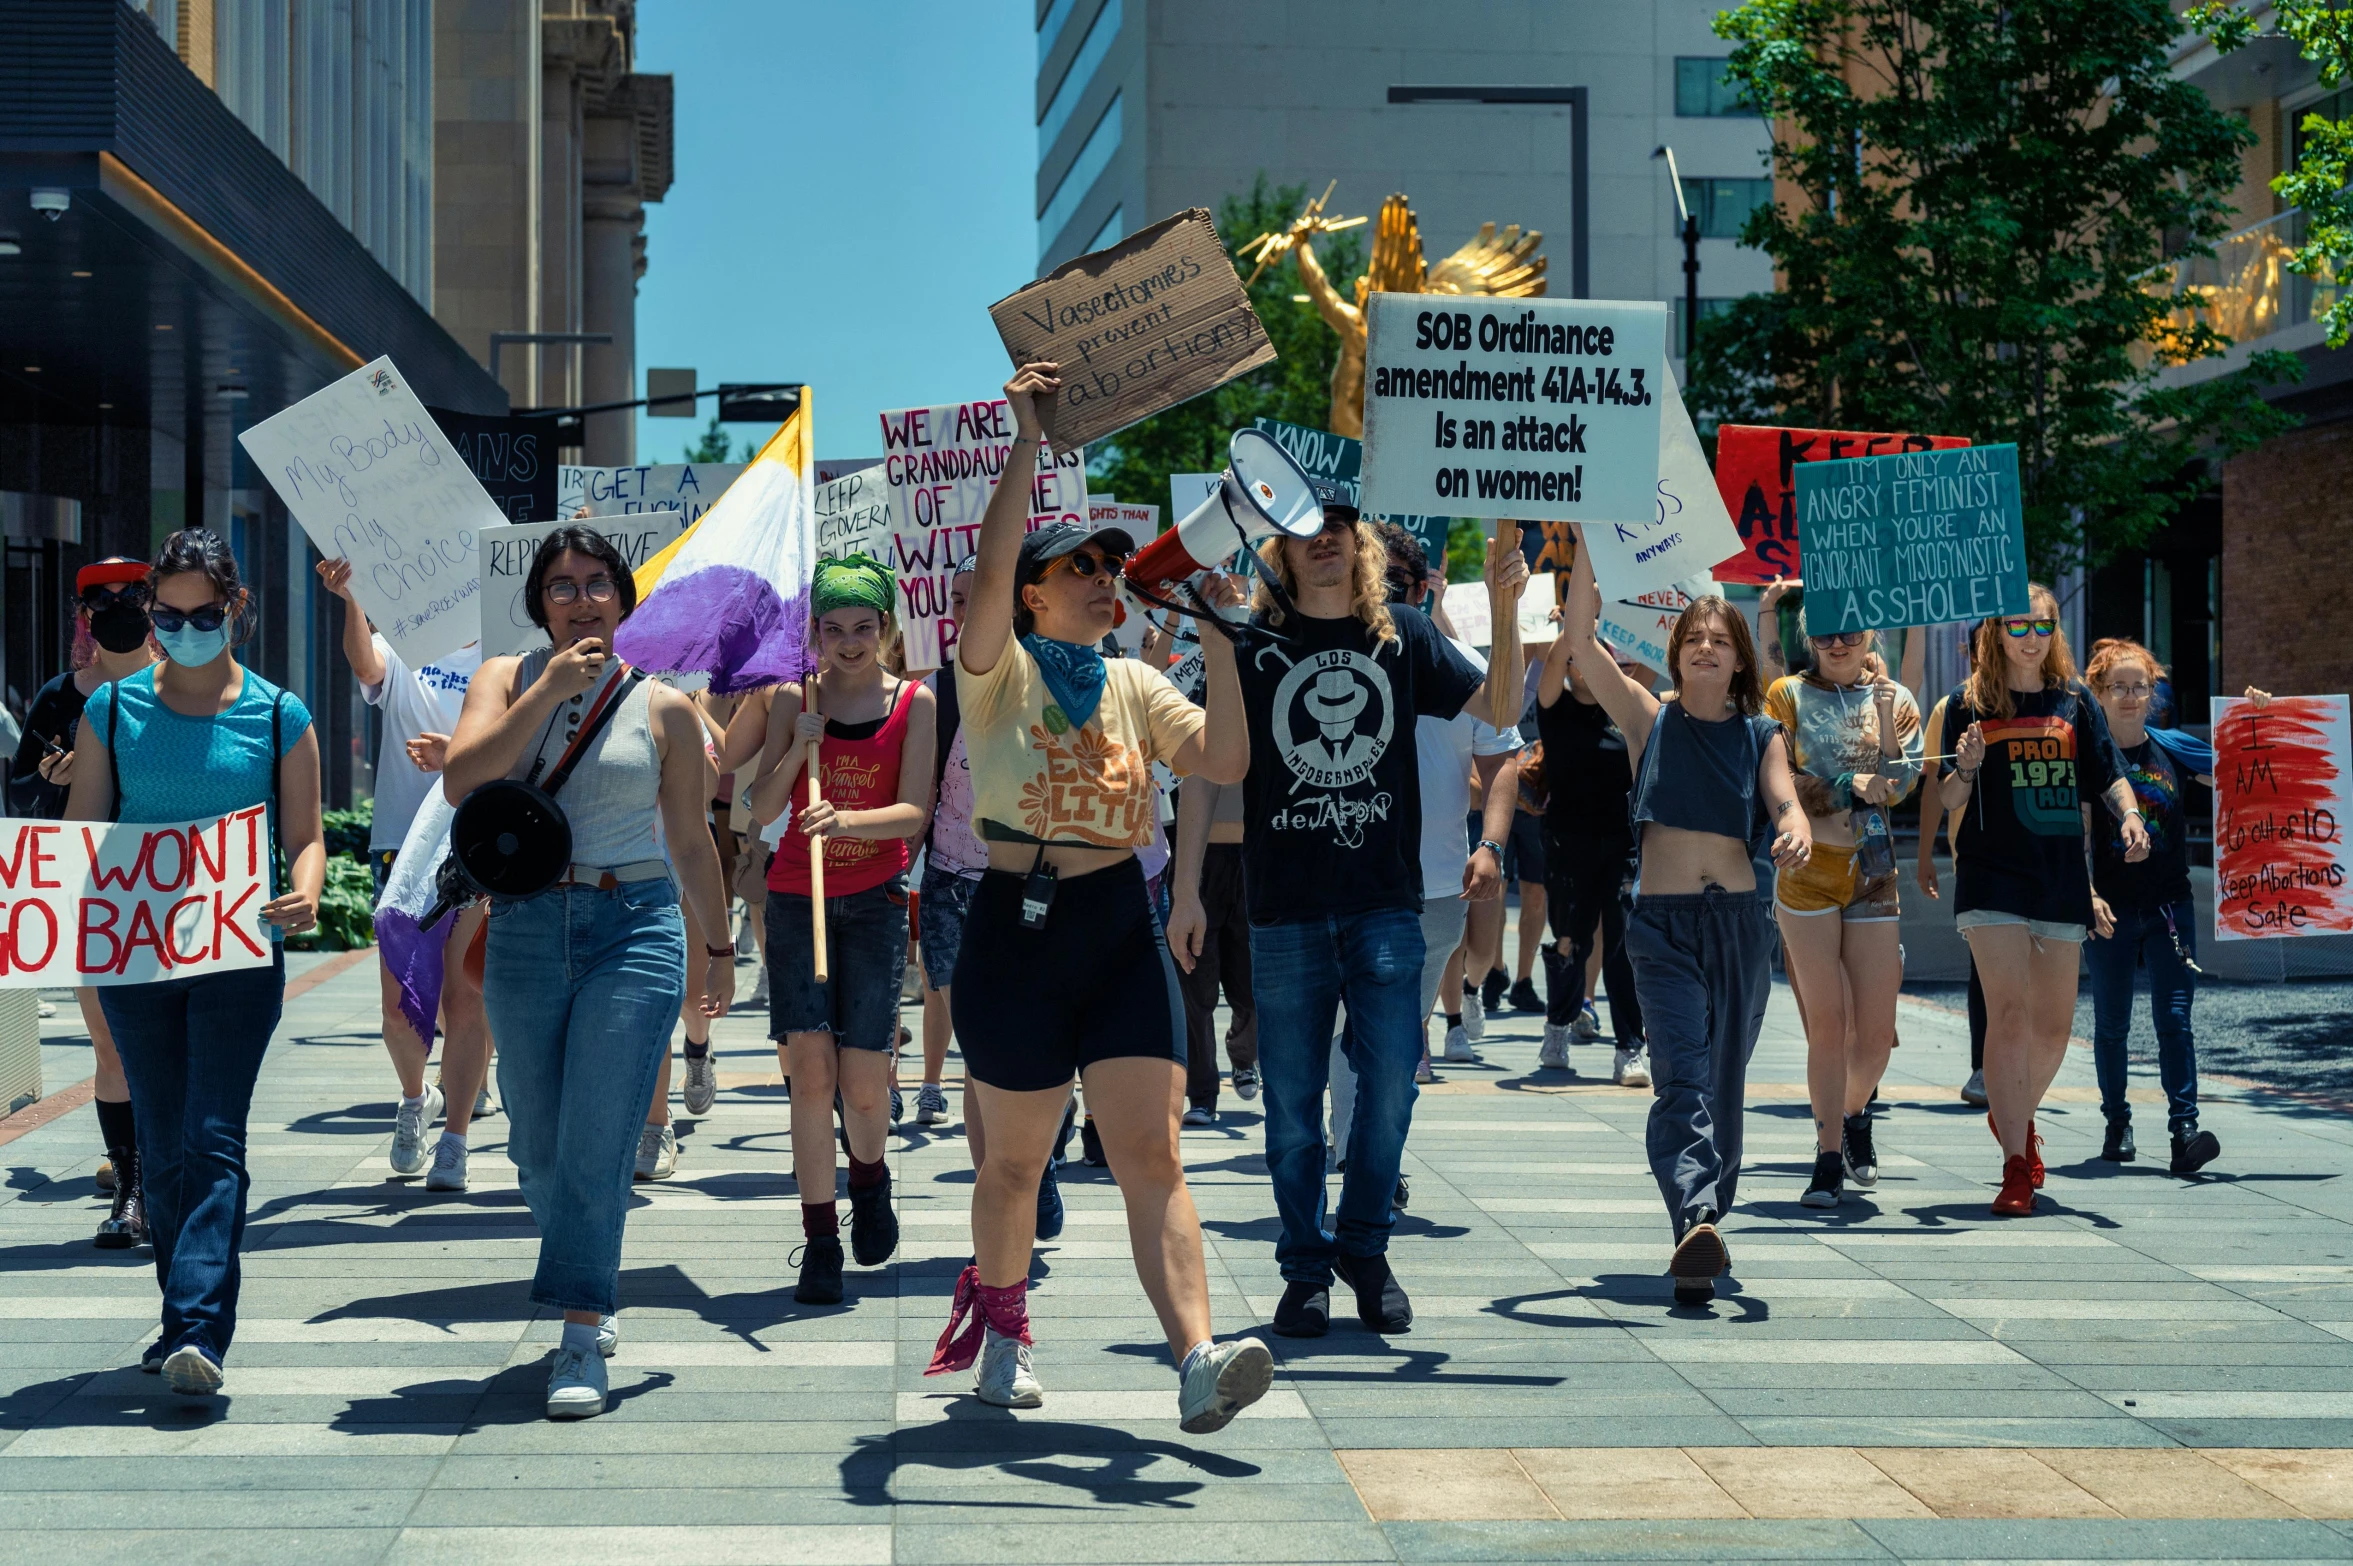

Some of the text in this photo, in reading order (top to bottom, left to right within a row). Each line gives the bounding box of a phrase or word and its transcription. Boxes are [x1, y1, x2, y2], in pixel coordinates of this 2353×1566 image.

[1023, 255, 1201, 334] Vasectomies
[1076, 303, 1173, 363] prevent
[1416, 310, 1614, 356] SOB Ordinance
[1068, 315, 1254, 406] abortions
[1375, 361, 1651, 406] amendment 41A-14.3.
[881, 400, 1012, 449] WE ARE
[1435, 411, 1587, 453] Is an attack
[285, 419, 441, 508] My Body
[1275, 424, 1345, 474] KNOW
[1849, 448, 1988, 484] I'M ONLY AN
[591, 465, 700, 501] GET A
[1436, 465, 1582, 502] on women!
[1807, 472, 2000, 522] ANGRY FEMINIST
[915, 485, 952, 527] OF
[1122, 509, 1149, 521] THAN
[335, 513, 402, 560] My
[1635, 532, 1683, 563] ANYWAYS
[1811, 509, 2006, 550] WHEN YOU'RE AN
[1803, 535, 2014, 593] IGNORANT MISOGYNISTIC
[898, 575, 947, 619] YOU
[1638, 591, 1687, 607] NEVER
[1840, 576, 2005, 631] ASSHOLE!
[1602, 619, 1636, 646] KEEP
[1315, 651, 1352, 668] LOS
[1802, 705, 1838, 732] KEY
[2241, 715, 2276, 751] I
[836, 755, 858, 767] I'M A
[2008, 738, 2058, 762] PRO
[819, 763, 880, 789] Damsel
[848, 788, 860, 799] IN
[2236, 758, 2278, 795] AM
[1271, 808, 1306, 830] de
[2227, 808, 2335, 851] 6 out of 10
[81, 805, 265, 893] WON'T
[2260, 862, 2346, 896] Abortions
[76, 882, 266, 976] BACK
[2245, 901, 2307, 929] Safe
